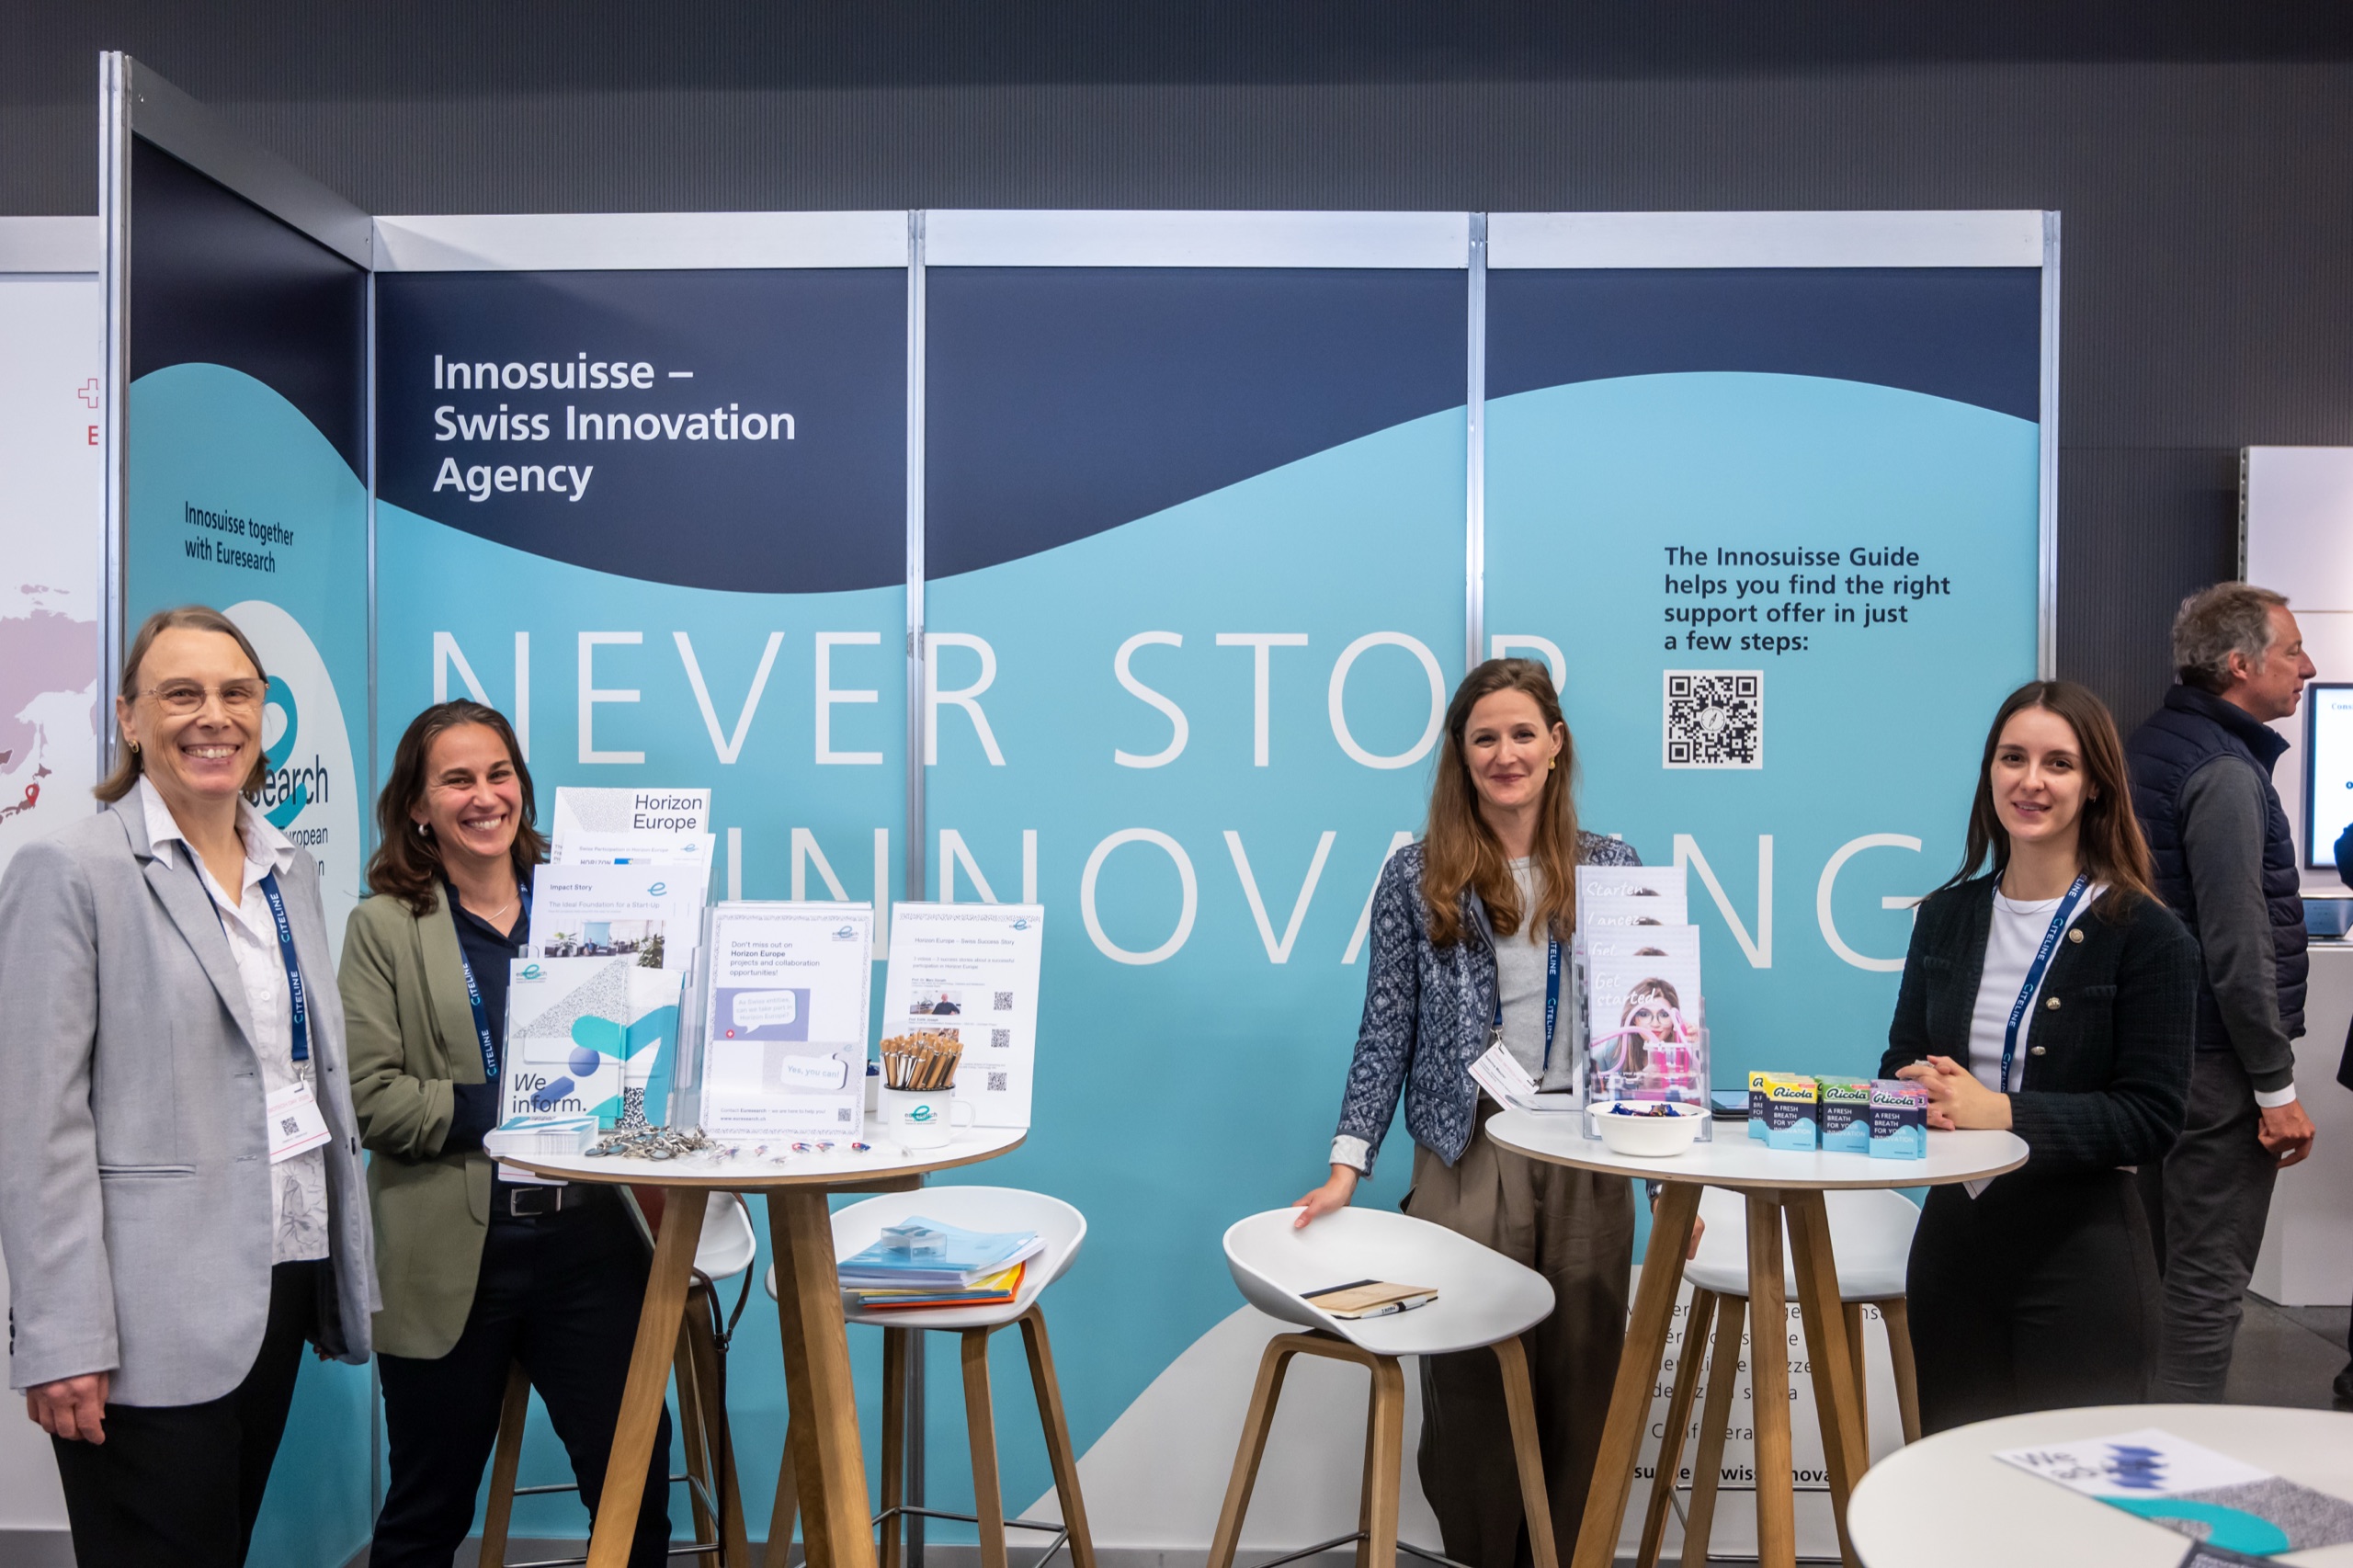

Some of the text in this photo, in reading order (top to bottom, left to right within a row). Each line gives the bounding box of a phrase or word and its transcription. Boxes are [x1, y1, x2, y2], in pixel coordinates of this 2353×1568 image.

[434, 352, 655, 390] Innosuisse
[434, 403, 796, 441] Swiss Innovation
[433, 458, 594, 503] Agency
[185, 501, 294, 547] Innosuisse together
[185, 536, 276, 574] with Euresearch
[1665, 546, 1920, 566] The Innosuisse Guide
[1665, 574, 1950, 600] helps you find the right
[1665, 602, 1908, 629] support offer in just
[1664, 631, 1809, 655] a few steps:
[433, 631, 1006, 767] NEVER
[253, 755, 328, 808] earch
[635, 794, 703, 811] Horizon
[633, 813, 697, 834] Europe
[279, 826, 328, 848] ropean
[1586, 881, 1643, 897] Starten
[2068, 873, 2087, 898] ELINE
[727, 828, 1923, 972] INNOVNG
[269, 892, 290, 943] CITELINE
[2038, 917, 2064, 961] CITELINE
[1549, 937, 1557, 975] ITELINE
[463, 963, 481, 1006] CITELINE
[729, 969, 779, 977] opportunities!
[1595, 972, 1620, 990] Get
[290, 971, 304, 1024] CITELINE
[2008, 983, 2033, 1028] CITELINE
[1547, 997, 1556, 1040] CITELINE
[481, 1029, 497, 1077] CITELINE
[515, 1074, 547, 1092] We
[788, 1065, 803, 1074] Yes,
[805, 1068, 821, 1077] you
[513, 1096, 587, 1114] inform.
[1773, 1087, 1813, 1098] Ricola
[1826, 1088, 1867, 1099] Ricola
[1873, 1093, 1915, 1106] Ricola
[1773, 1127, 1812, 1135] INNOVATION
[1827, 1130, 1866, 1138] INNOVATION
[1874, 1135, 1914, 1143] INNOVATION
